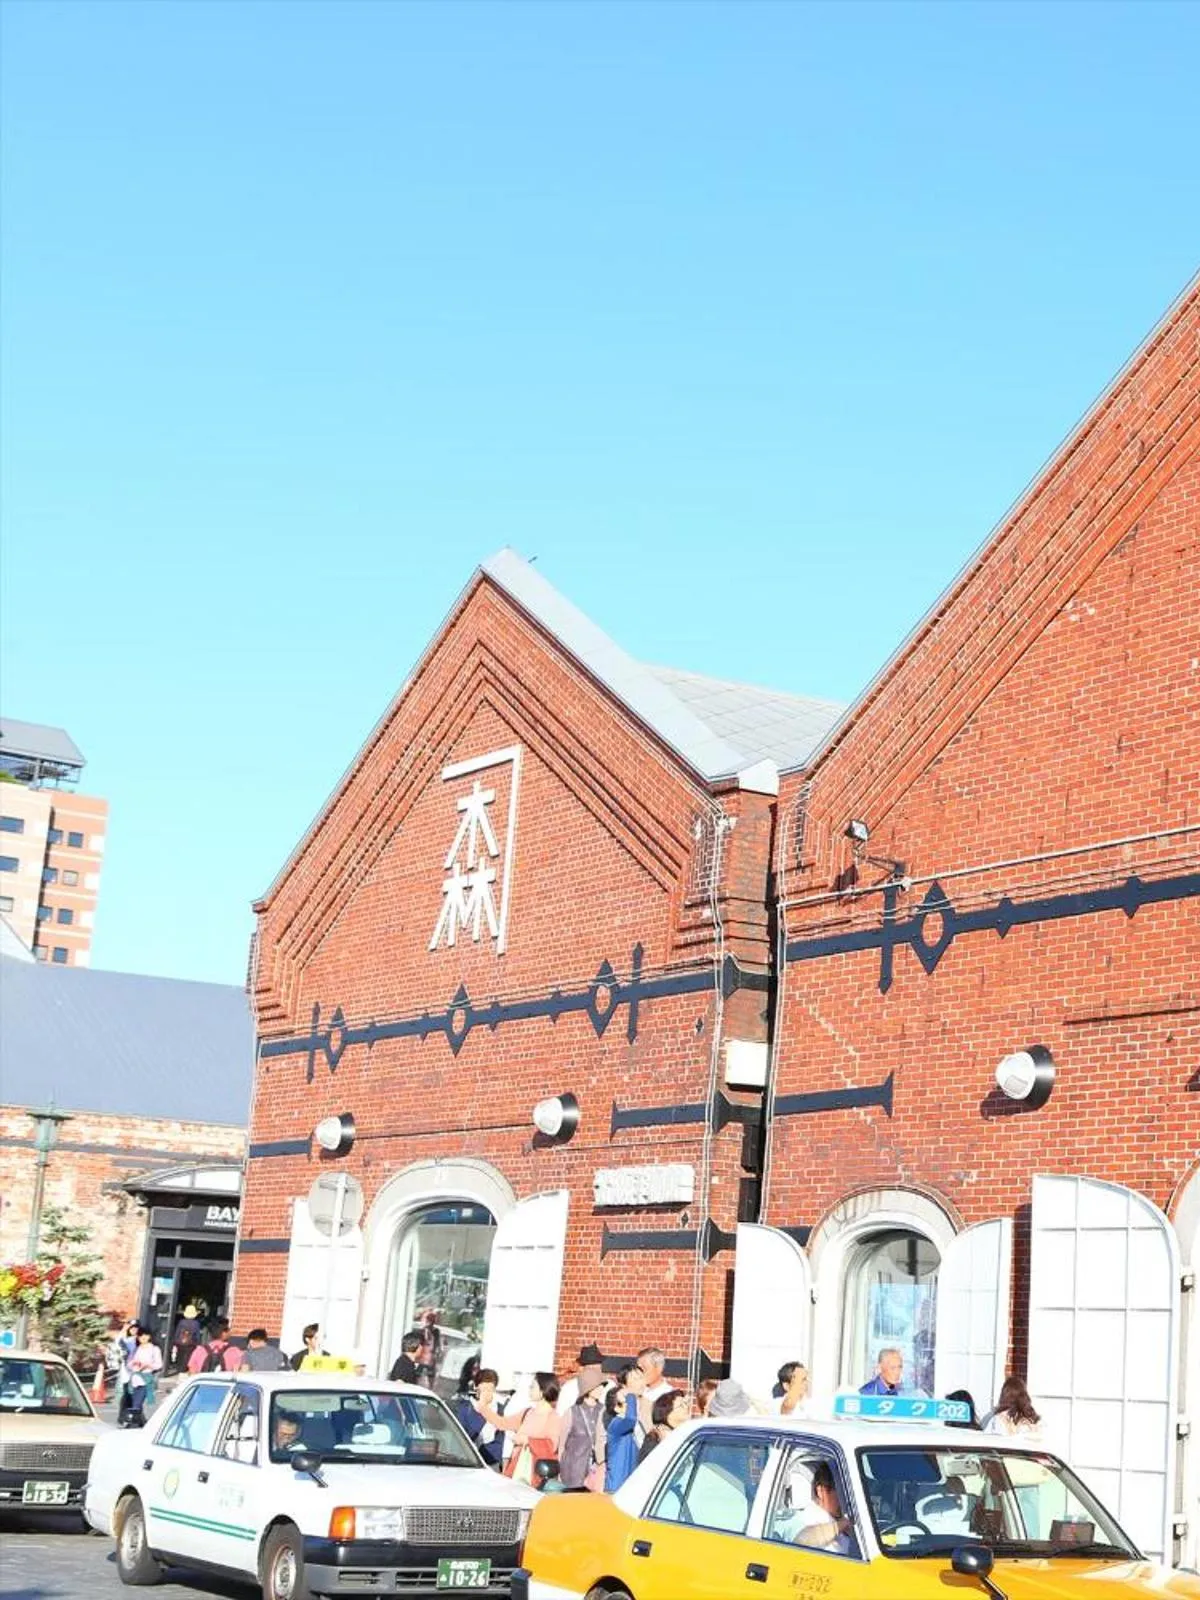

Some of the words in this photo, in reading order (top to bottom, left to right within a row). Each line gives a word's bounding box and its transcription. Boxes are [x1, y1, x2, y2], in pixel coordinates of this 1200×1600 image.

[205, 1205, 241, 1221] BAY
[938, 1402, 967, 1419] 202
[448, 1570, 486, 1587] 10-26
